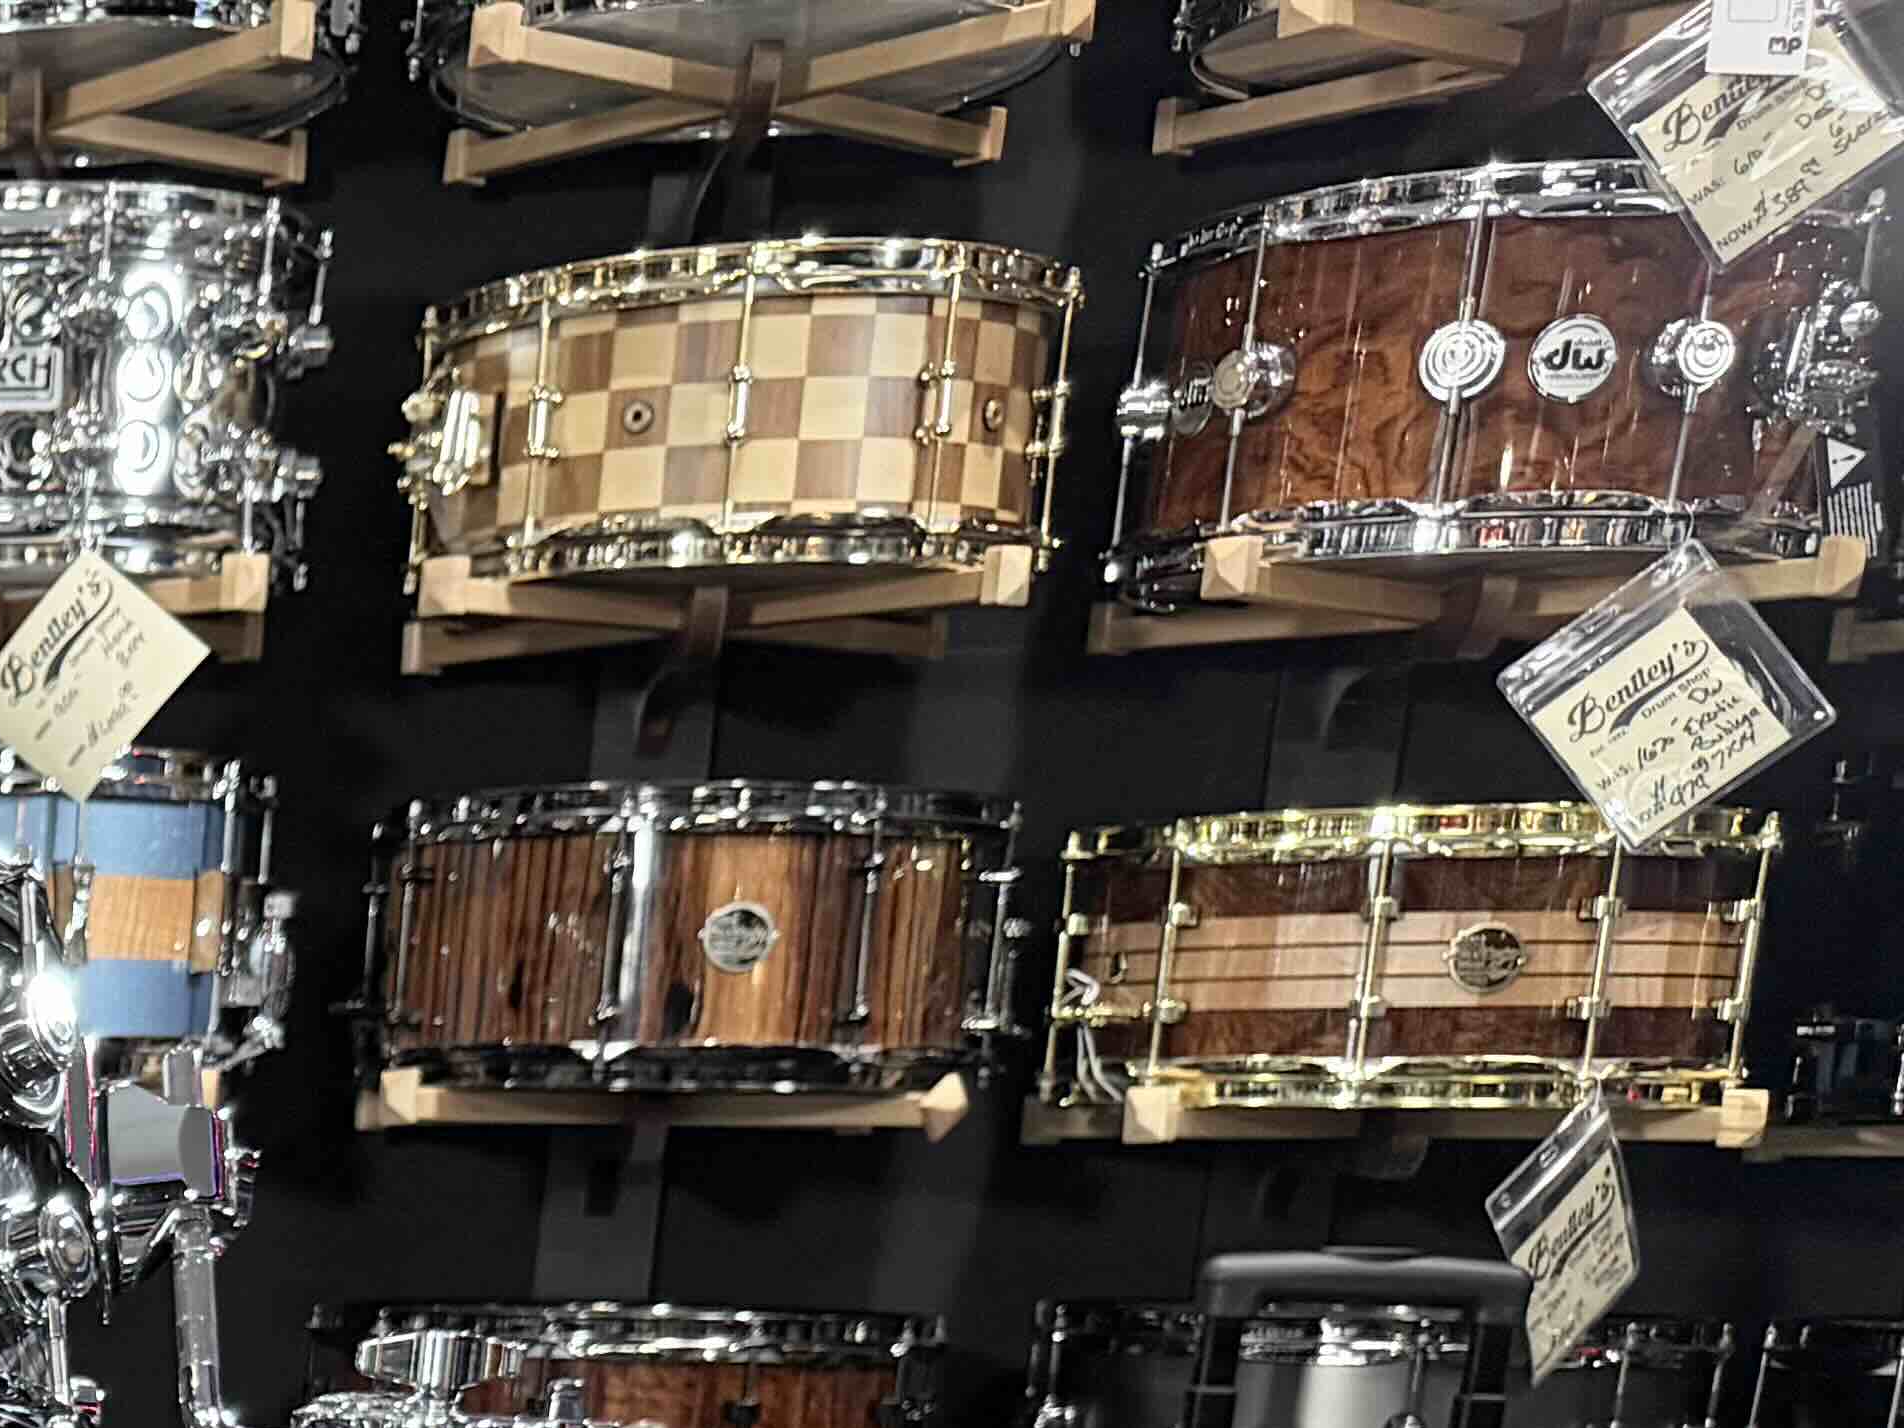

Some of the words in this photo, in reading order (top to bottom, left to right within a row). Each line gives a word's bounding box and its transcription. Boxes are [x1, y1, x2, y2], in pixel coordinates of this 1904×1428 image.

[1543, 340, 1607, 371] dw
[0, 569, 103, 706] Bentley's
[1568, 639, 1699, 744] Bentley's
[1641, 690, 1677, 721] Drum
[1678, 666, 1713, 695] Shop
